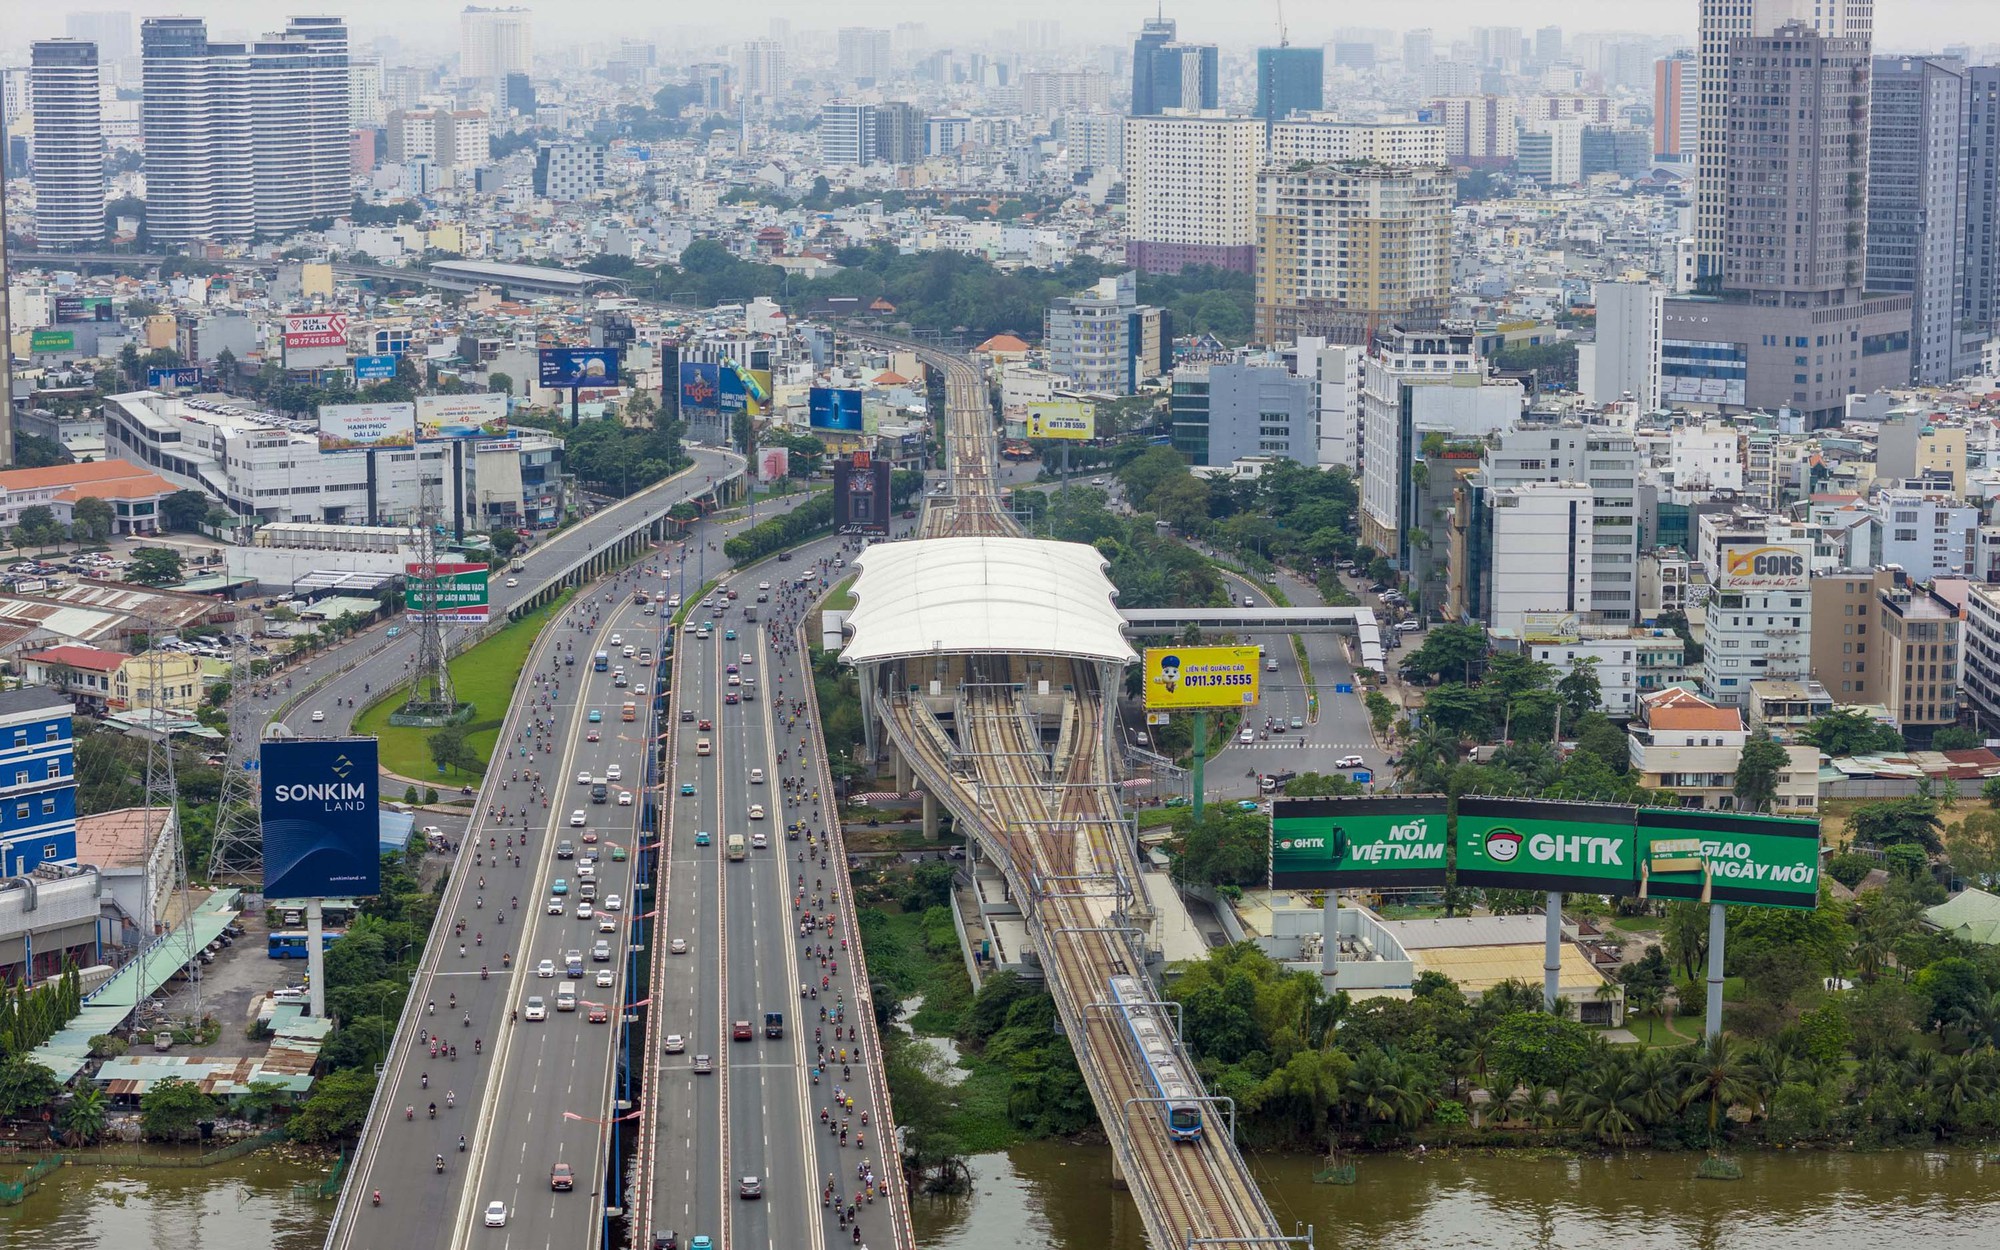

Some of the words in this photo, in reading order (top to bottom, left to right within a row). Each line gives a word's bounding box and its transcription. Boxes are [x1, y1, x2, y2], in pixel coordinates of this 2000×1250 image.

[684, 383, 714, 403] Tiger
[1185, 665, 1199, 673] LIÊN
[1232, 664, 1245, 672] CÁO
[1184, 674, 1252, 687] 0911.39.5555
[275, 782, 365, 802] SONKIM
[324, 801, 366, 812] LAND
[1388, 818, 1428, 841] NỐI
[1293, 837, 1325, 849] GHTK
[1528, 833, 1624, 867] GHTK
[1709, 858, 1770, 880] NGÀY
[1769, 862, 1815, 884] MỚI
